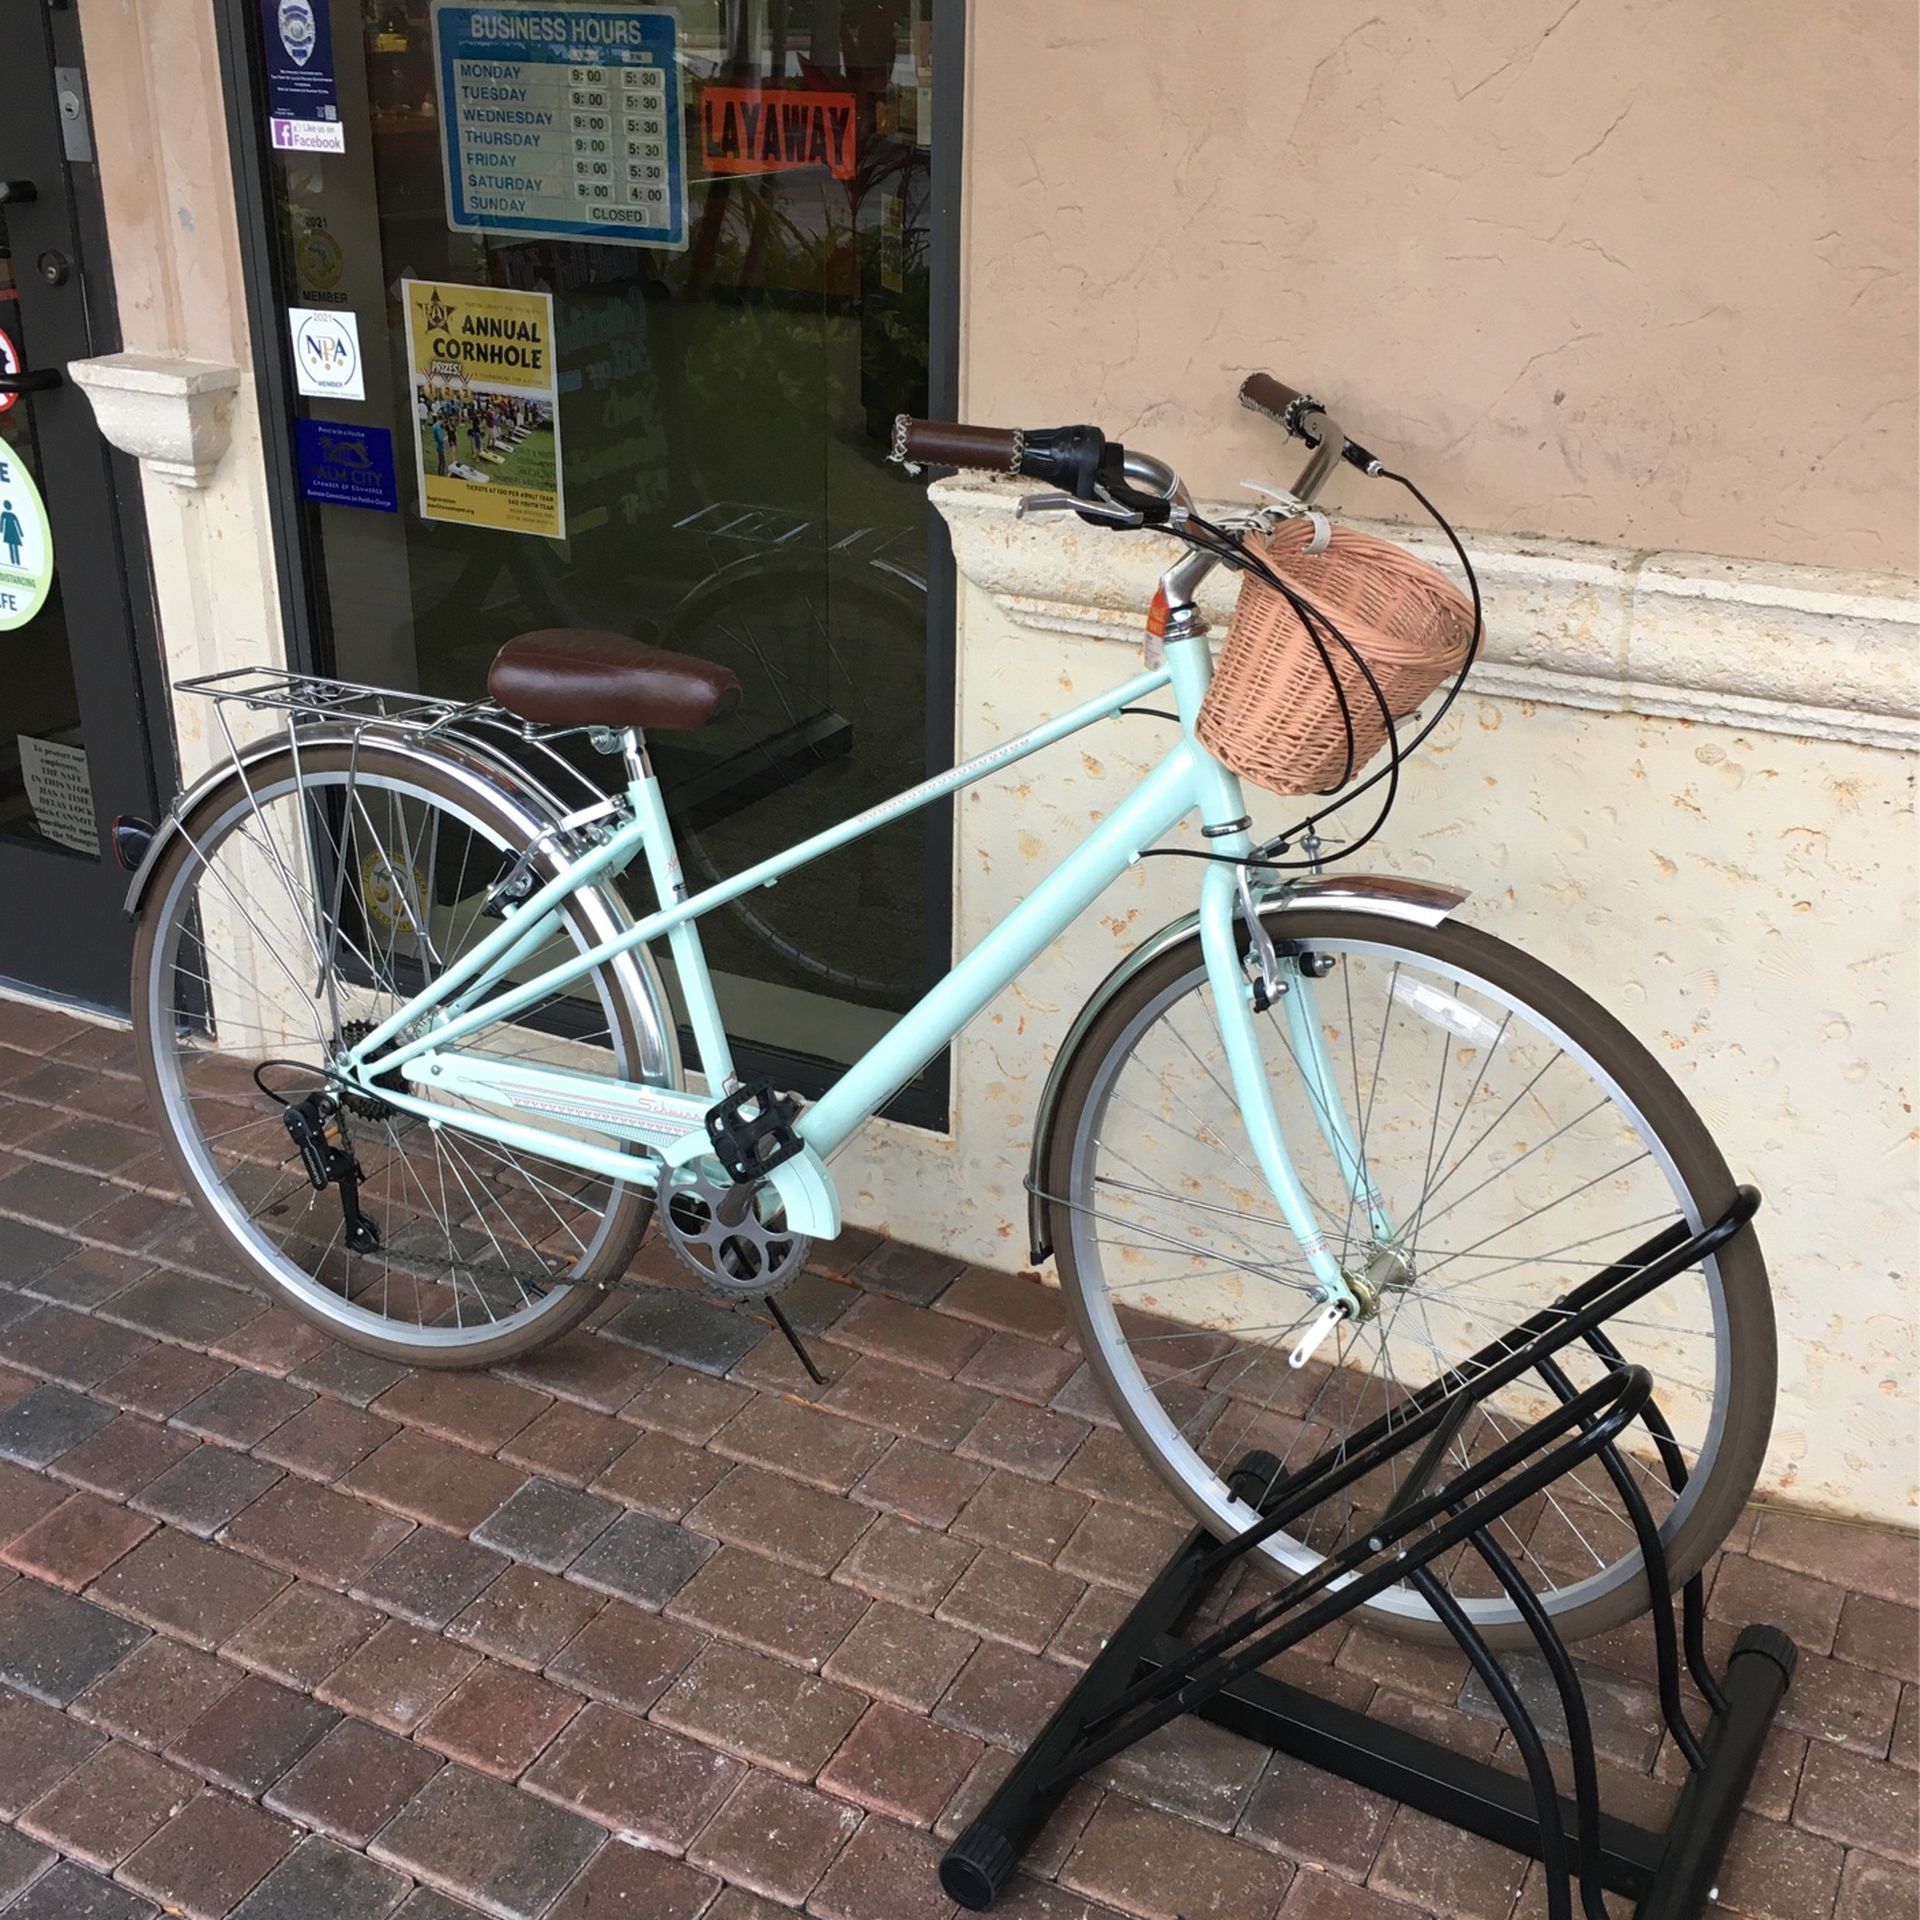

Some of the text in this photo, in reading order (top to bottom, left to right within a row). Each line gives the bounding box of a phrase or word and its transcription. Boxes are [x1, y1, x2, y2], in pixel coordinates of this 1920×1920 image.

[470, 14, 642, 44] BUSINESS HOURS
[460, 63, 521, 79] MONDAY
[462, 86, 527, 102] TUESDAY
[463, 109, 553, 125] WEDNESDAY
[303, 123, 317, 133] Like
[705, 101, 851, 166] LAYAWAY
[294, 134, 342, 149] Facebook
[465, 130, 540, 147] THURSDAY
[466, 152, 516, 168] FRIDAY
[468, 174, 543, 192] SATURDAY
[470, 196, 642, 223] SUNDAY CLOSED
[305, 216, 328, 228] 2021
[302, 290, 349, 304] MEMBER
[312, 312, 332, 322] 2021
[462, 315, 541, 342] ANNUAL
[305, 334, 348, 362] NPA
[433, 338, 542, 369] CORNHOLE
[431, 360, 462, 376] PRIZES!
[351, 469, 383, 487] CITY
[0, 592, 18, 612] FE
